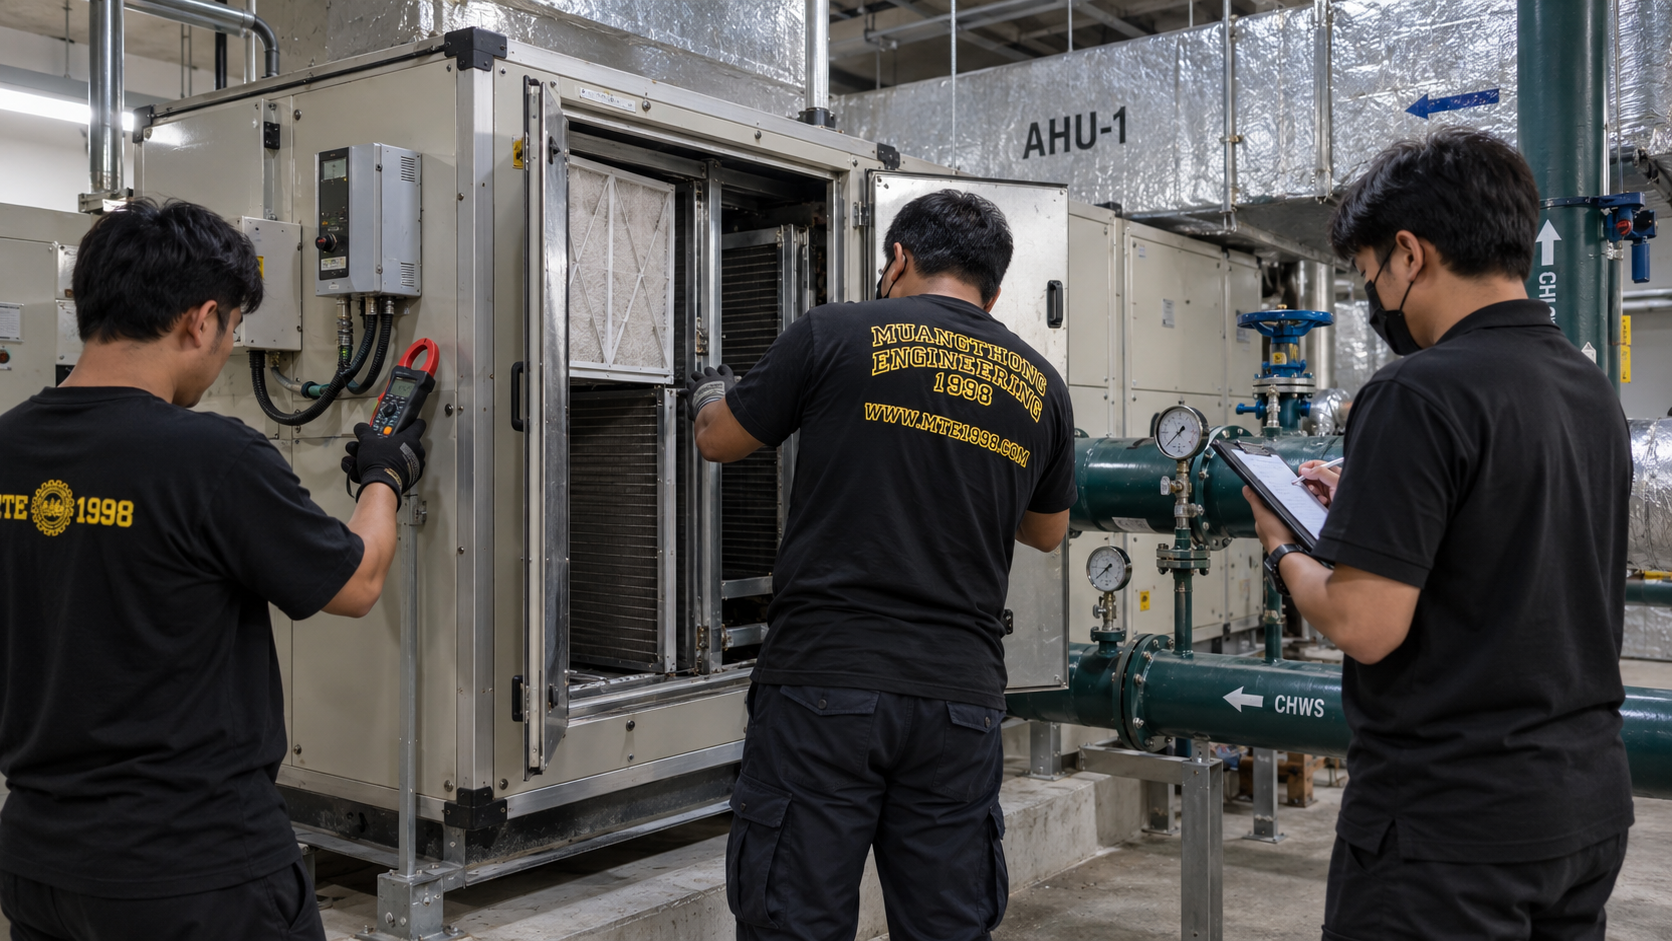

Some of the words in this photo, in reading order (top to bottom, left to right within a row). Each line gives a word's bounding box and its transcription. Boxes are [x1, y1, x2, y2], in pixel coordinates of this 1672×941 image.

[1022, 105, 1126, 160] AHU-1
[871, 323, 1047, 396] MUANGTHONG
[872, 346, 1043, 423] ENGINEERING
[933, 372, 993, 406] 1998
[864, 402, 1031, 468] WWW.MTE1998.COM
[0, 494, 28, 520] TE
[76, 496, 134, 528] 1998
[1274, 694, 1325, 718] CHWS
